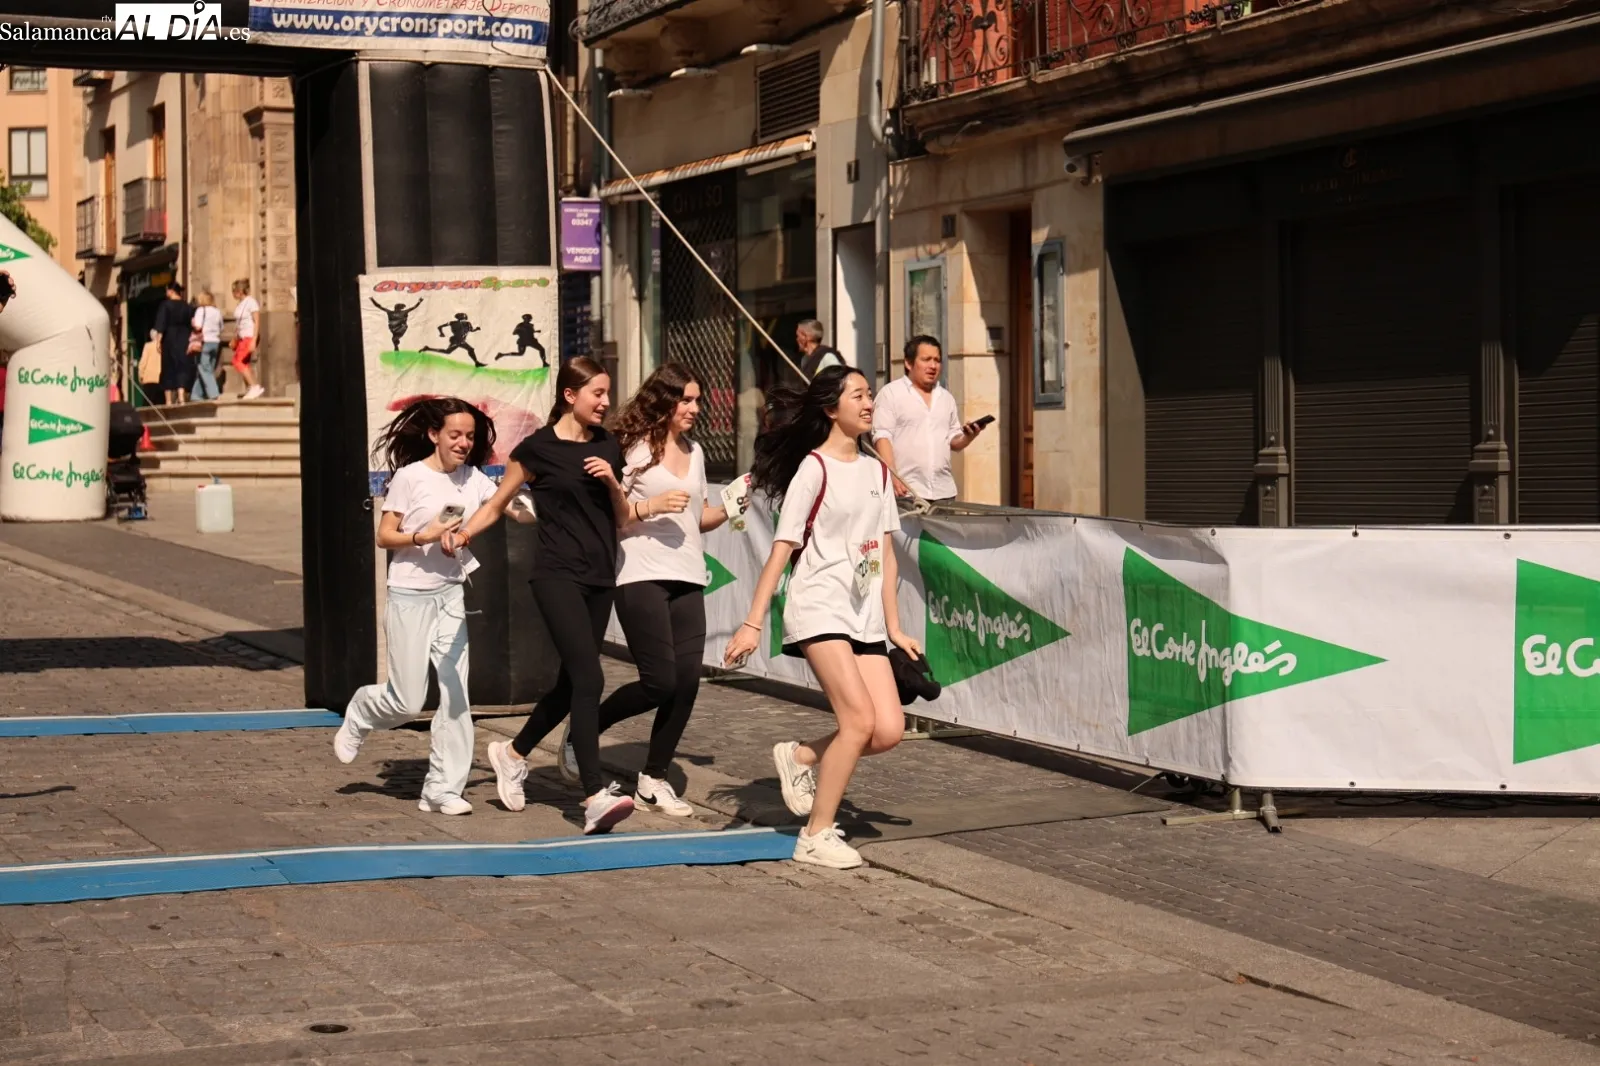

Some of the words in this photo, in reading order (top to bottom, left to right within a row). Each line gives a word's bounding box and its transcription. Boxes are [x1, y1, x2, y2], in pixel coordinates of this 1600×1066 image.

[272, 12, 533, 40] www.orycronsport.com
[566, 246, 600, 255] VENDIDO
[374, 276, 550, 293] OrycronSport
[18, 367, 30, 384] El
[31, 368, 68, 386] Corte
[13, 462, 25, 479] El
[26, 463, 64, 481] Corte
[928, 590, 943, 624] El
[942, 595, 976, 632] Corte
[1130, 618, 1151, 657] El
[1151, 623, 1195, 666] Corte
[1197, 619, 1297, 687] Inglés
[1521, 634, 1564, 676] El
